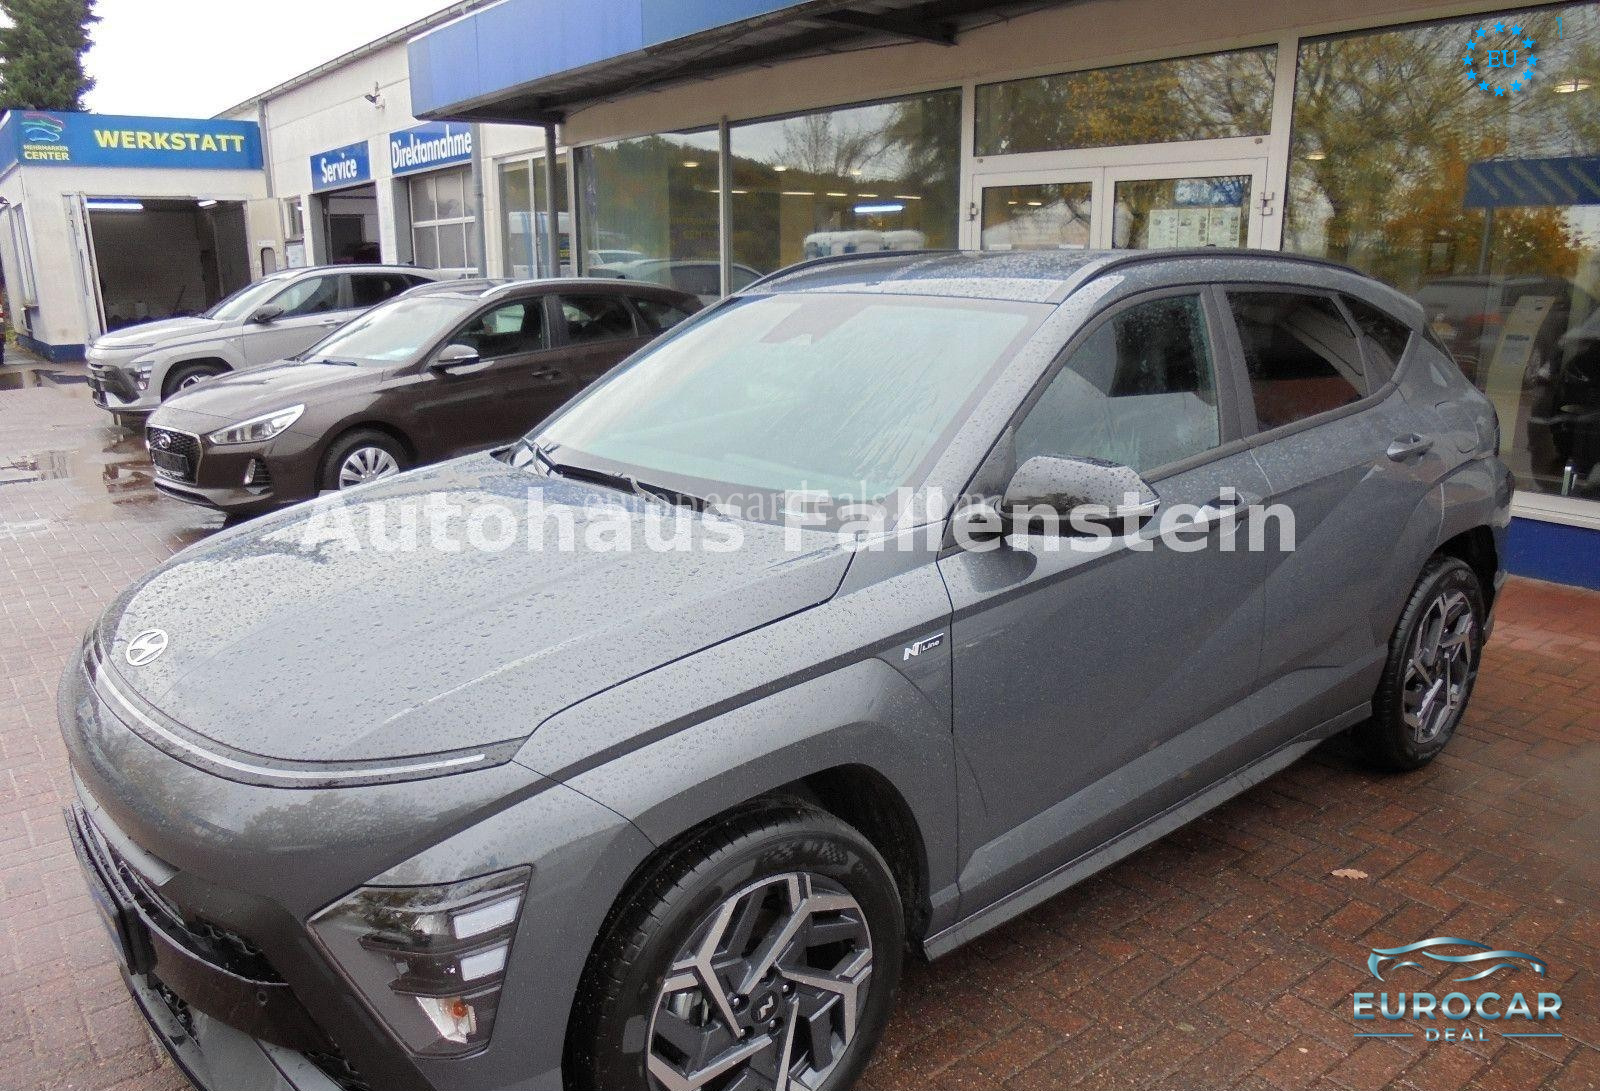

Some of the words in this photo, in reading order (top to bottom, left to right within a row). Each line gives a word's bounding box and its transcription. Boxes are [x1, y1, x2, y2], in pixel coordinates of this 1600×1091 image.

[94, 129, 245, 153] WERKSTATT
[391, 124, 472, 169] Direktannahme
[24, 151, 71, 161] CENTER
[321, 153, 357, 184] Service
